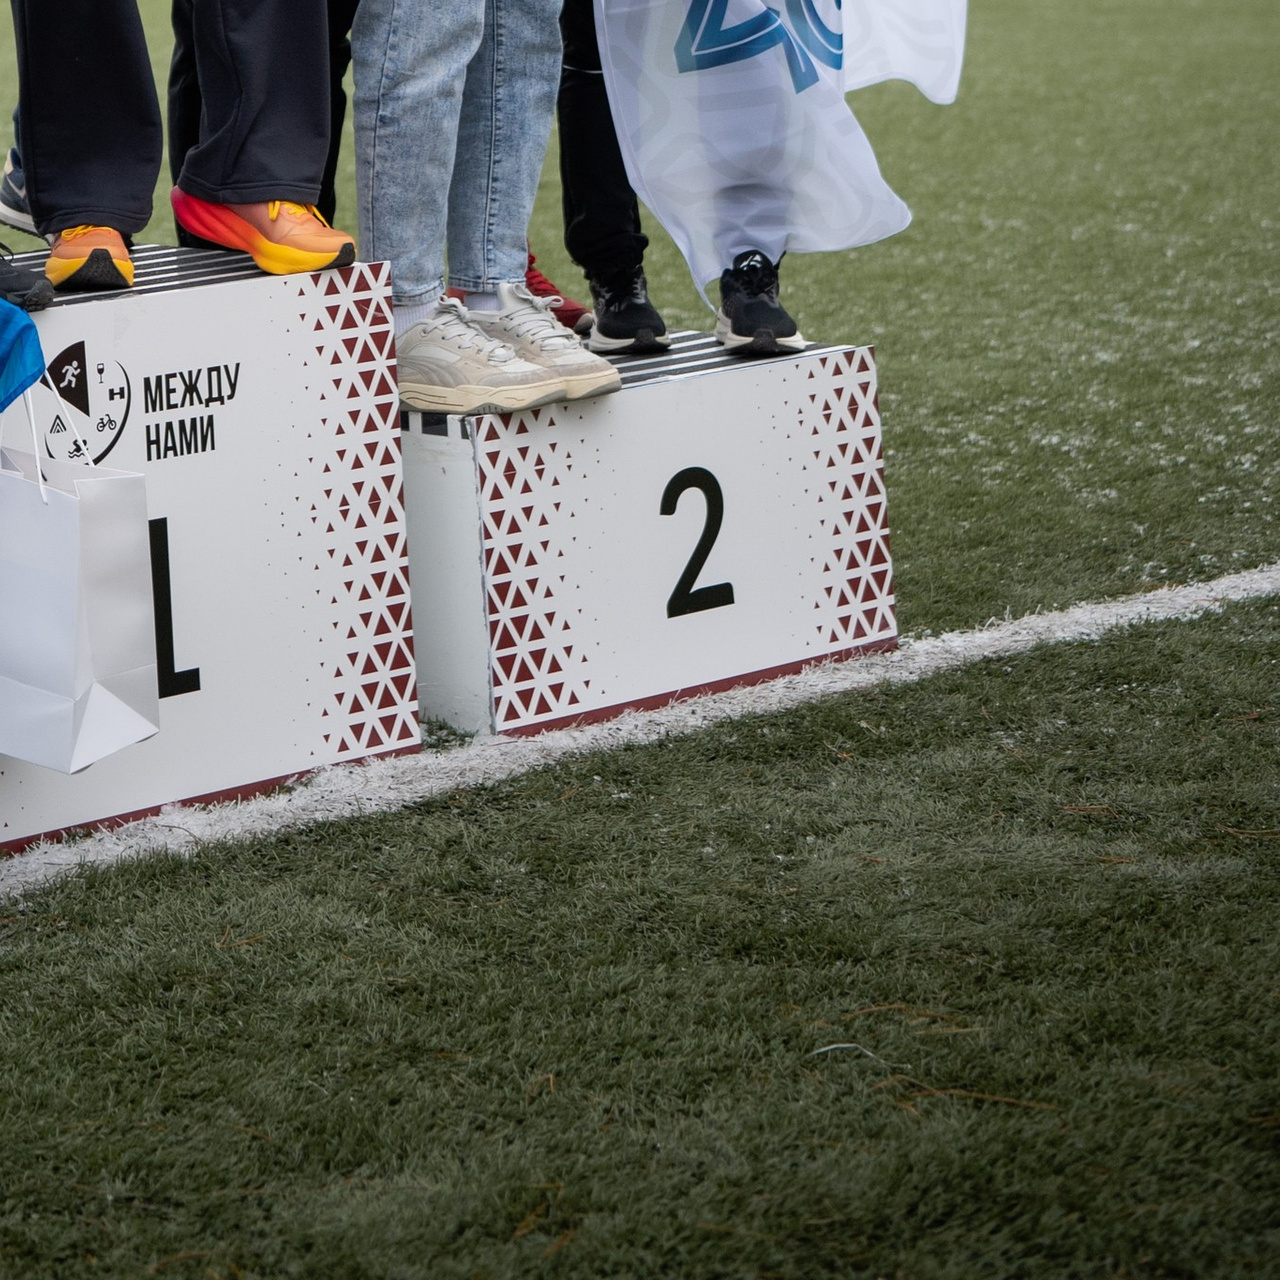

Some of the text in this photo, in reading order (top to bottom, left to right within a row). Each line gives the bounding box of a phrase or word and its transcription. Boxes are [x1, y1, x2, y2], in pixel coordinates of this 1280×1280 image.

[143, 362, 241, 413] МЕЖДУ
[145, 415, 216, 461] НАМИ
[659, 466, 735, 618] 2
